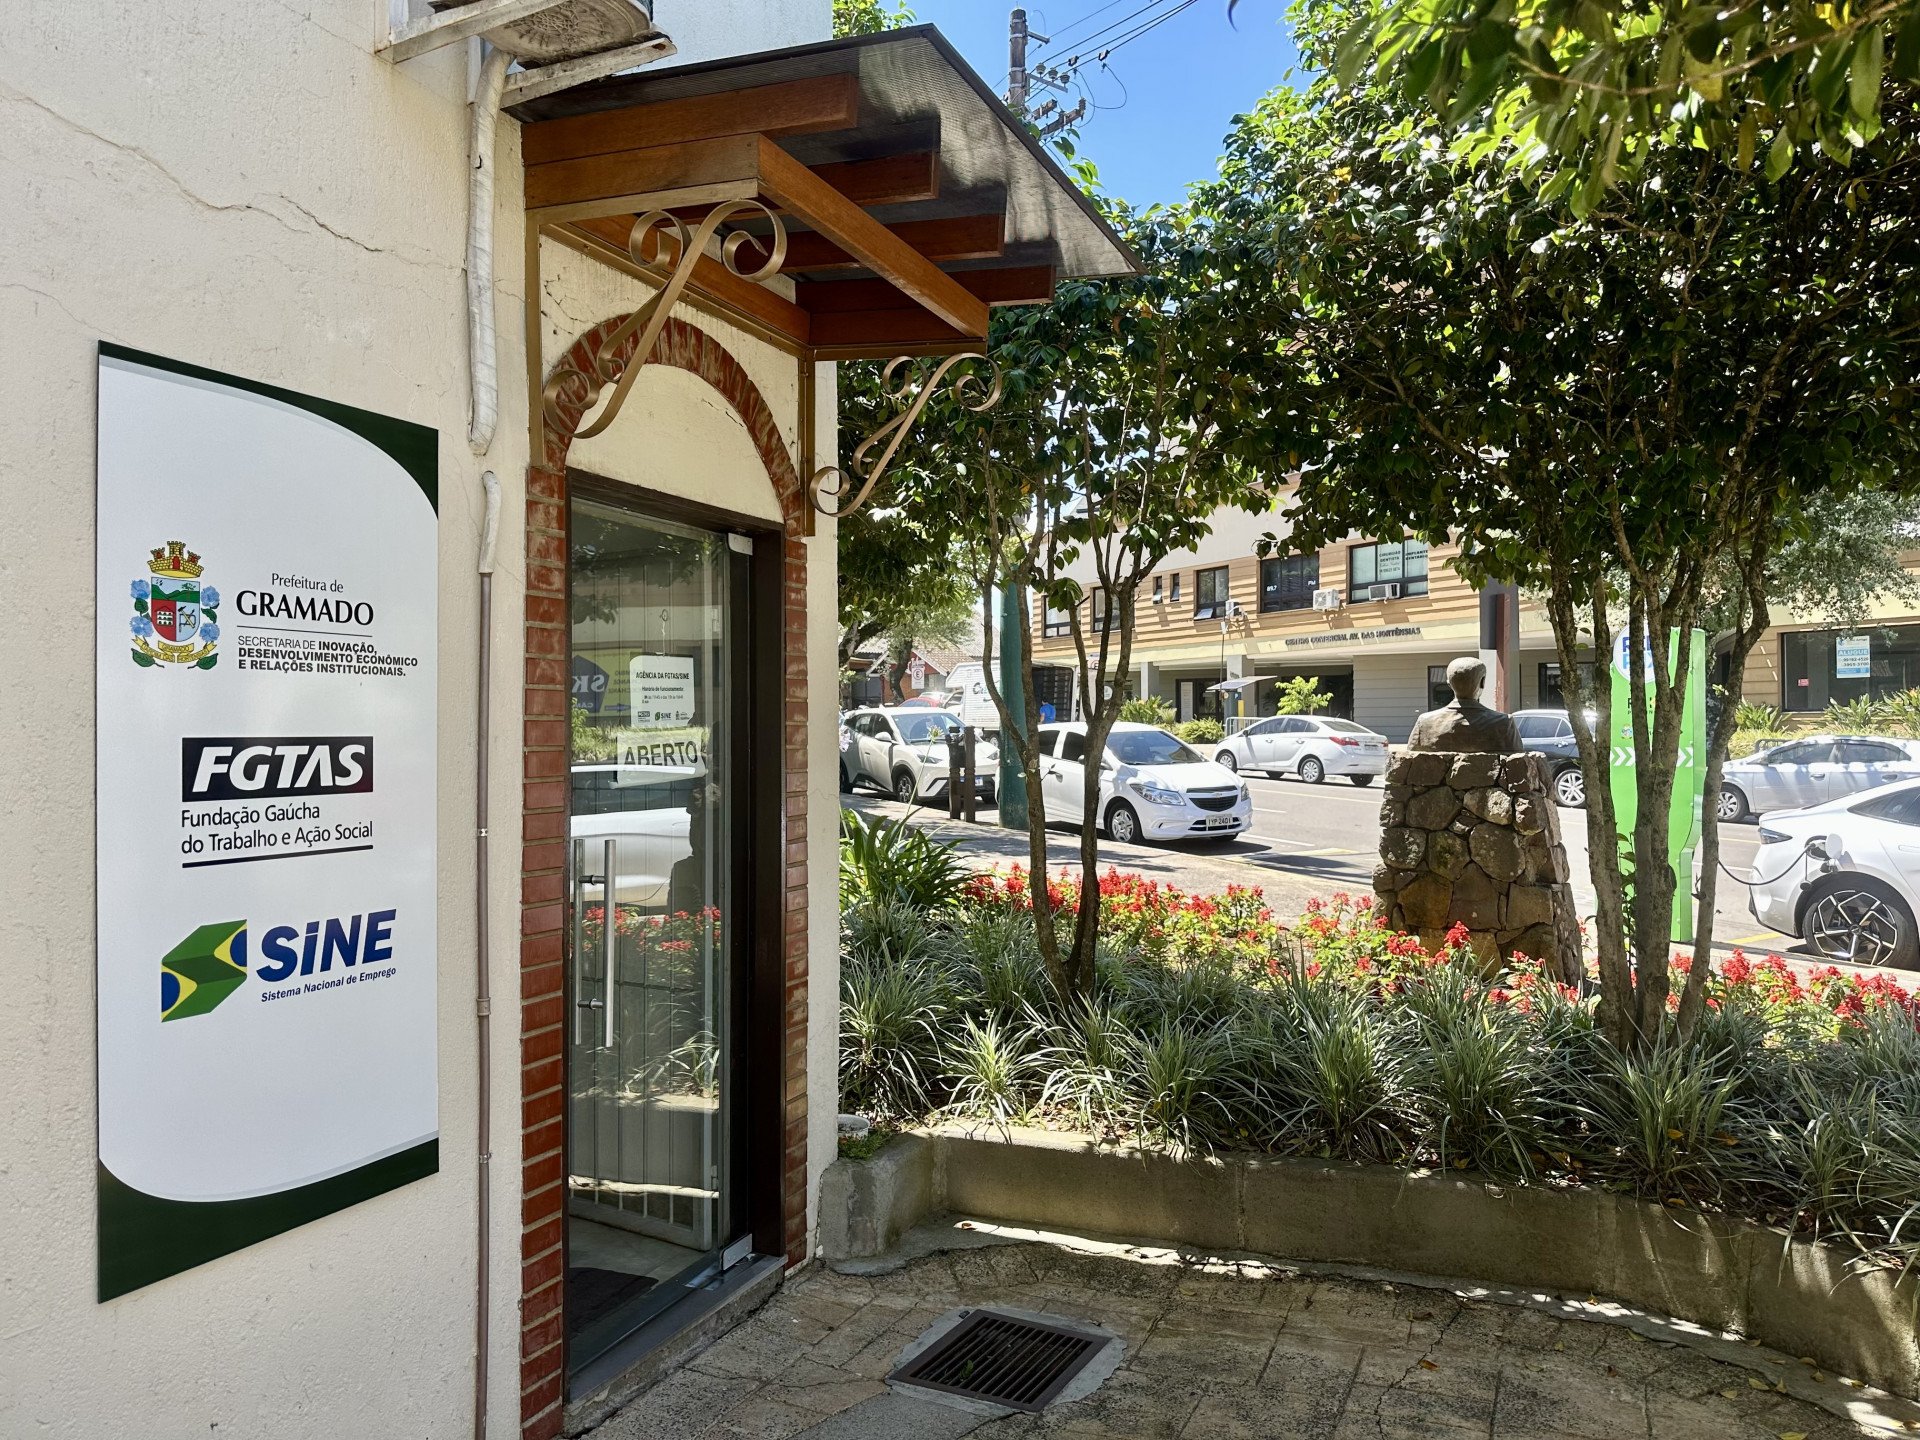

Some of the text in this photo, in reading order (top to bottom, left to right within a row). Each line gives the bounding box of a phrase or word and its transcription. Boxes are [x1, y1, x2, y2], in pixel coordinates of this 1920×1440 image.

[272, 573, 344, 593] Prefeitura de
[236, 590, 374, 626] GRAMADO
[238, 636, 377, 655] SECRETARIA DE INOVAÇÃO,
[1311, 634, 1347, 643] COMERCIAL
[1361, 631, 1375, 639] DAS
[238, 648, 418, 667] DESENVOLVIMENTO ECONÔMICO
[238, 659, 406, 676] E RELAÇÕES INSTITUCIONAIS.
[636, 671, 656, 679] AGÊNCIA
[623, 741, 698, 766] ABERTO
[192, 744, 366, 792] FGTAS
[182, 802, 320, 829] Fundação Gaúcha
[182, 821, 373, 854] do Trabalho e Ação Social
[261, 967, 397, 1003] Sistema Nacional de Emprego
